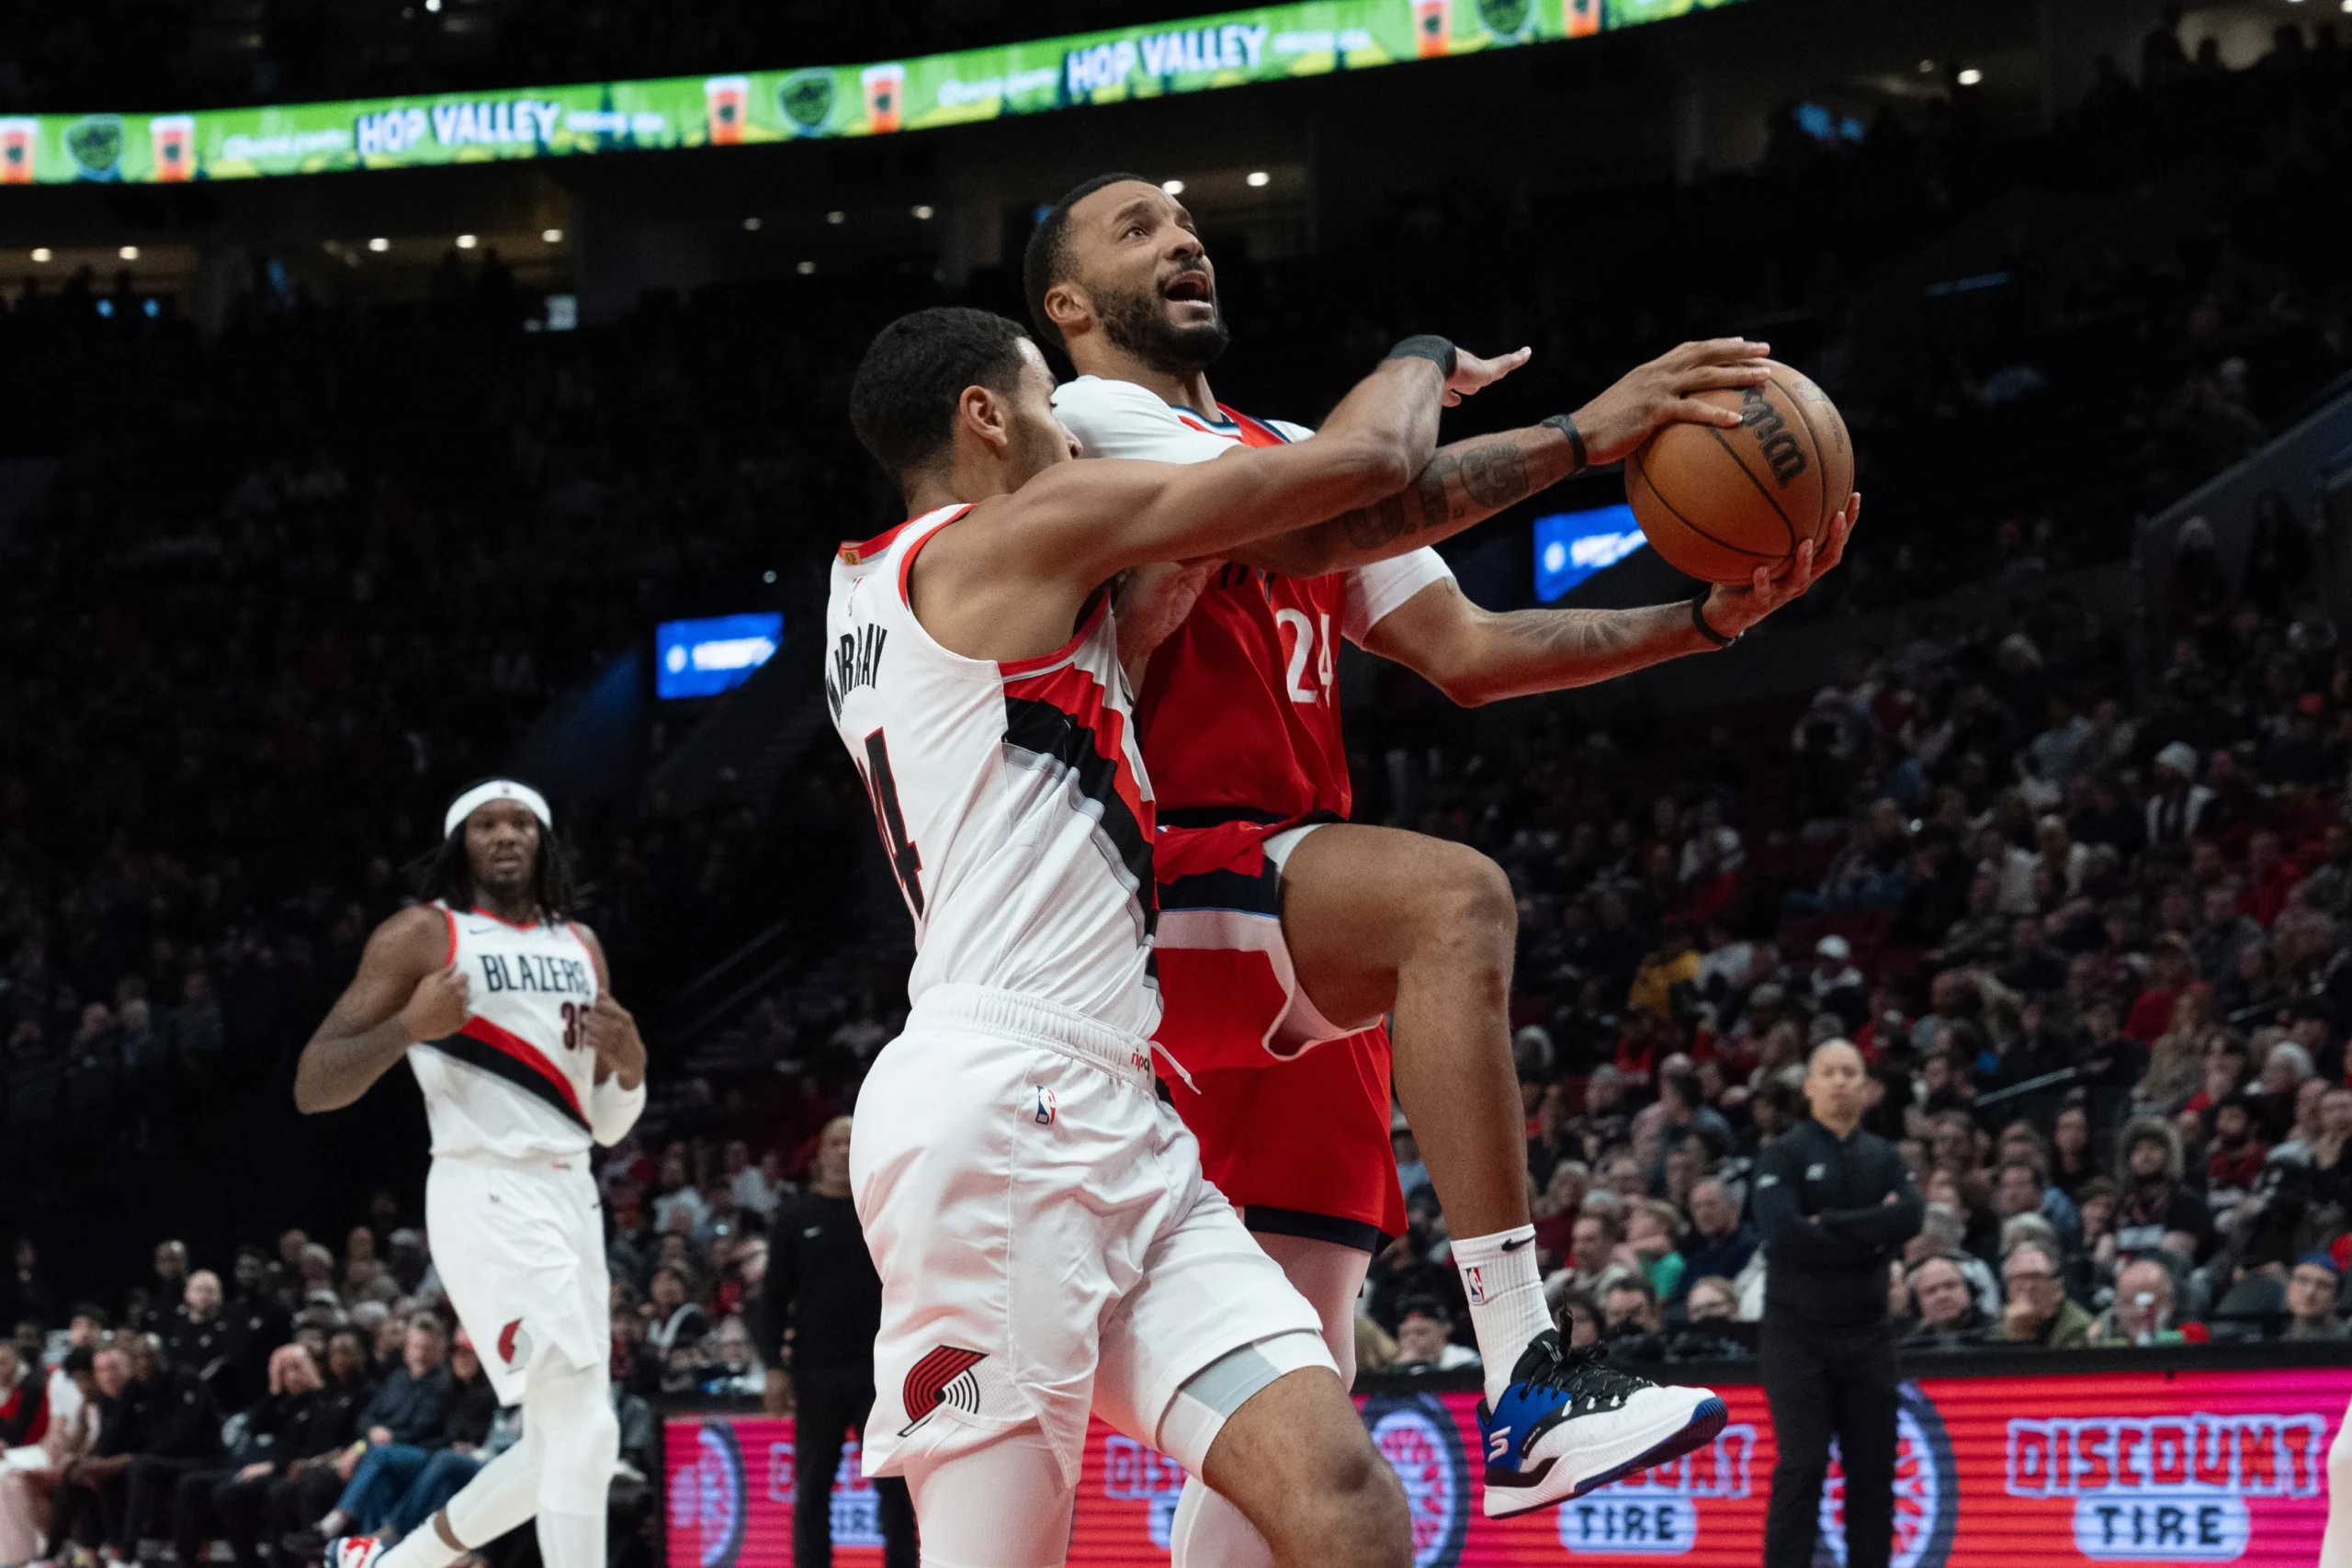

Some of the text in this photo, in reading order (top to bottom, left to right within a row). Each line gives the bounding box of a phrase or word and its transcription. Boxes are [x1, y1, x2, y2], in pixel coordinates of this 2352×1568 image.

[1066, 40, 1137, 94] HOP
[1141, 24, 1268, 76] VALLEY
[356, 107, 427, 157] HOP
[431, 100, 561, 145] VALLEY
[1275, 607, 1334, 708] 24
[856, 727, 923, 922] 4
[2007, 1412, 2326, 1498] DISCOUNT
[1576, 1505, 1677, 1541] TIRE
[2095, 1506, 2224, 1545] TIRE
